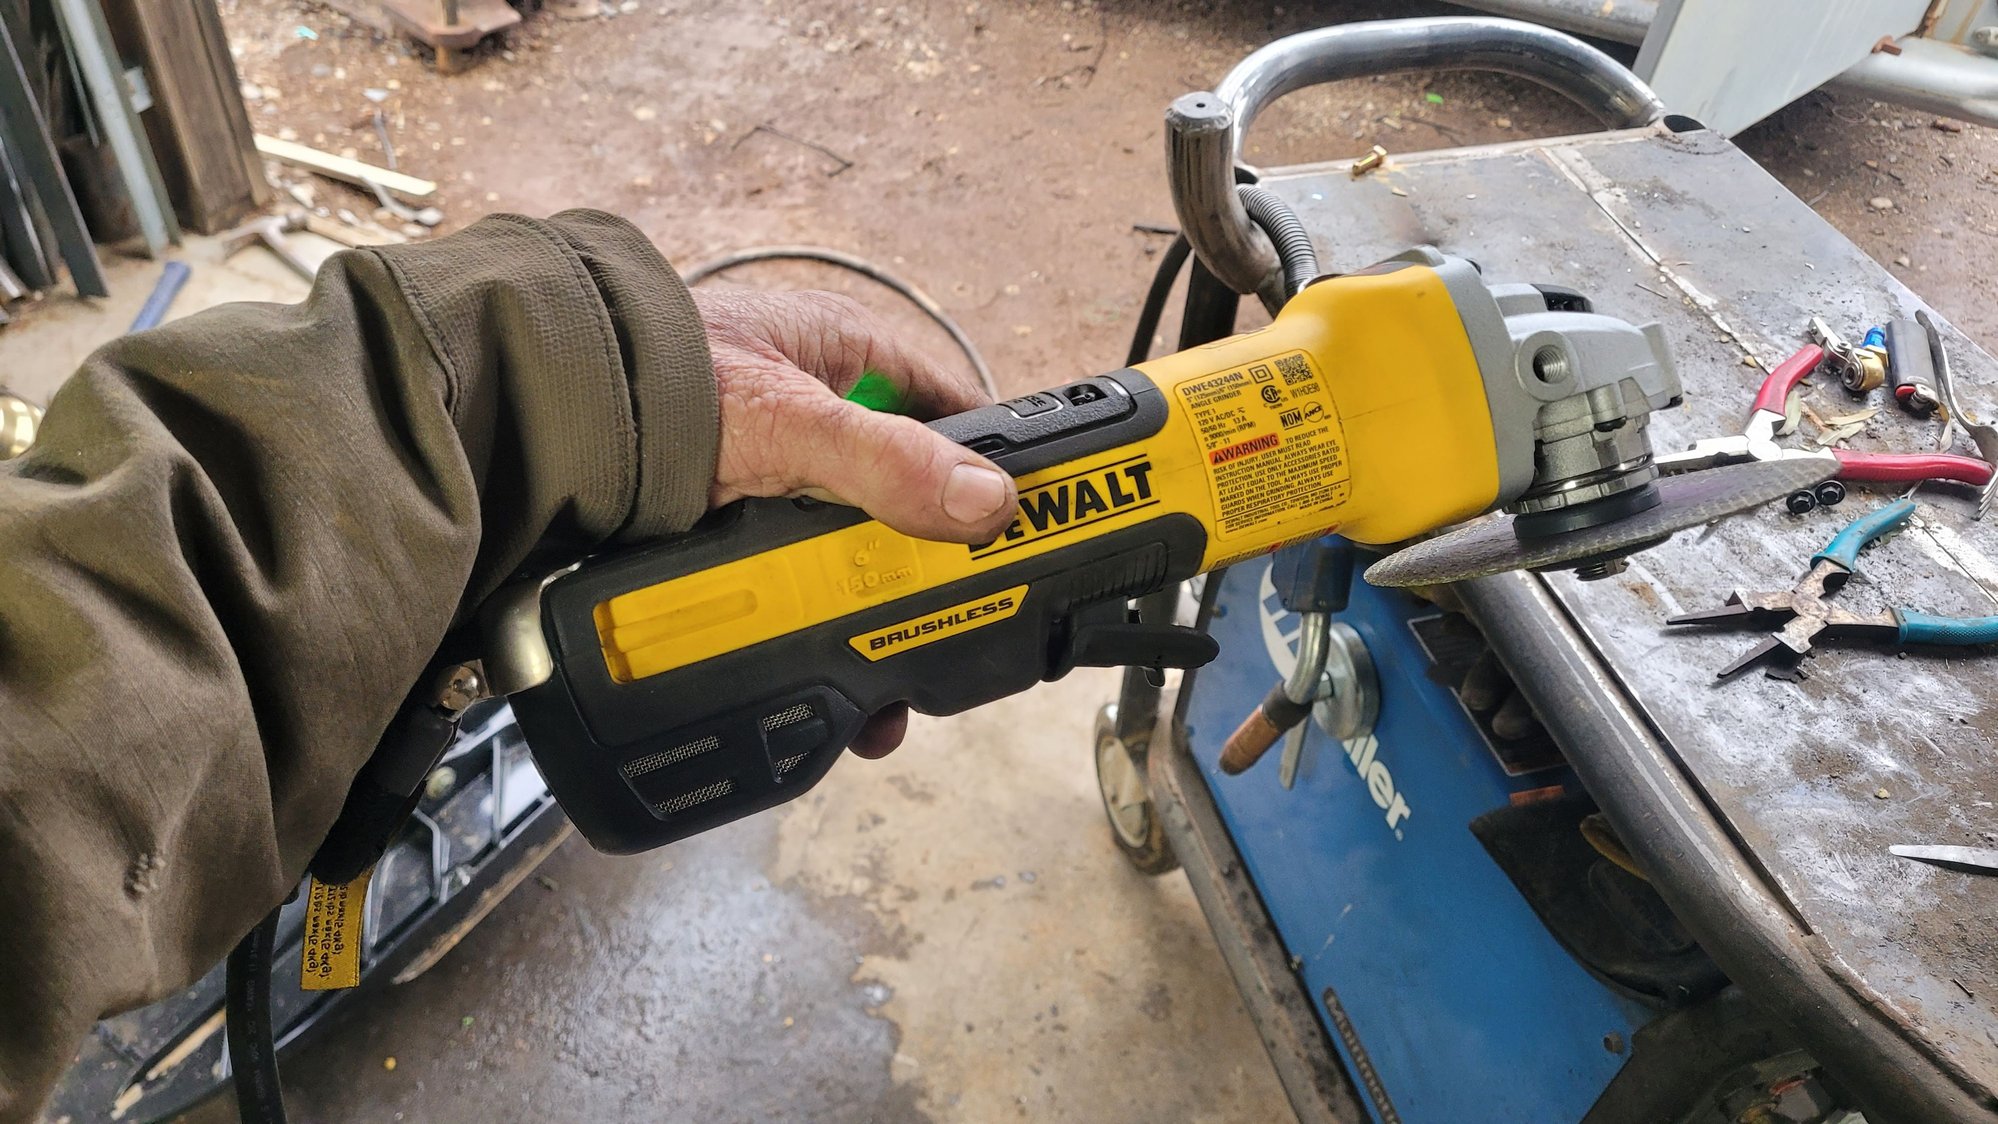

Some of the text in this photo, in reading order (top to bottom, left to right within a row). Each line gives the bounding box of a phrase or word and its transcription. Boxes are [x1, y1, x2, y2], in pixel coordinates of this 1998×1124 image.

[1182, 372, 1244, 396] DWE43244N
[1190, 389, 1242, 410] ANGLE GRINDER
[1194, 409, 1212, 419] TYPE
[1197, 418, 1209, 427] 120
[1215, 410, 1236, 421] AC/DC
[1200, 424, 1218, 434] 50/60
[1232, 417, 1241, 425] 13
[1236, 421, 1256, 431] (RPM)
[1280, 410, 1303, 428] NOM
[1213, 466, 1228, 474] RISK
[1228, 462, 1236, 470] OF
[1260, 450, 1277, 460] USER
[1277, 444, 1294, 455] MUST
[1295, 439, 1311, 449] READ
[1222, 437, 1231, 445] 11
[1222, 426, 1329, 460] WARNING TO REDUCE THE
[1215, 465, 1255, 482] INSTRUCTION
[1284, 448, 1308, 461] ALWAYS
[1308, 442, 1326, 453] WEAR
[1325, 439, 1336, 448] EYE
[1218, 454, 1338, 497] AT LEAST EQUAL TO THE MAXIMUM SPEED
[1254, 469, 1266, 478] USE
[1266, 464, 1282, 474] ONLY
[1283, 451, 1321, 468] ACCESSORIES
[1321, 445, 1340, 456] RATED
[1219, 491, 1245, 503] MARKED
[1245, 487, 1255, 496] ON
[1254, 484, 1266, 493] THE
[1284, 471, 1308, 483] ALWAYS
[1308, 467, 1320, 476] USE
[1320, 460, 1343, 471] PROPER
[1221, 498, 1246, 511] GUARDS
[1246, 492, 1265, 503] WHEN
[1297, 474, 1322, 486] ALWAYS
[1322, 470, 1333, 479] USE
[969, 461, 1152, 553] EWALT
[1222, 505, 1245, 517] PROPER
[1245, 493, 1285, 510] RESPIRATORY
[837, 566, 913, 596] 150mm
[869, 597, 1014, 651] BRUSHLESS
[1342, 734, 1411, 830] ller
